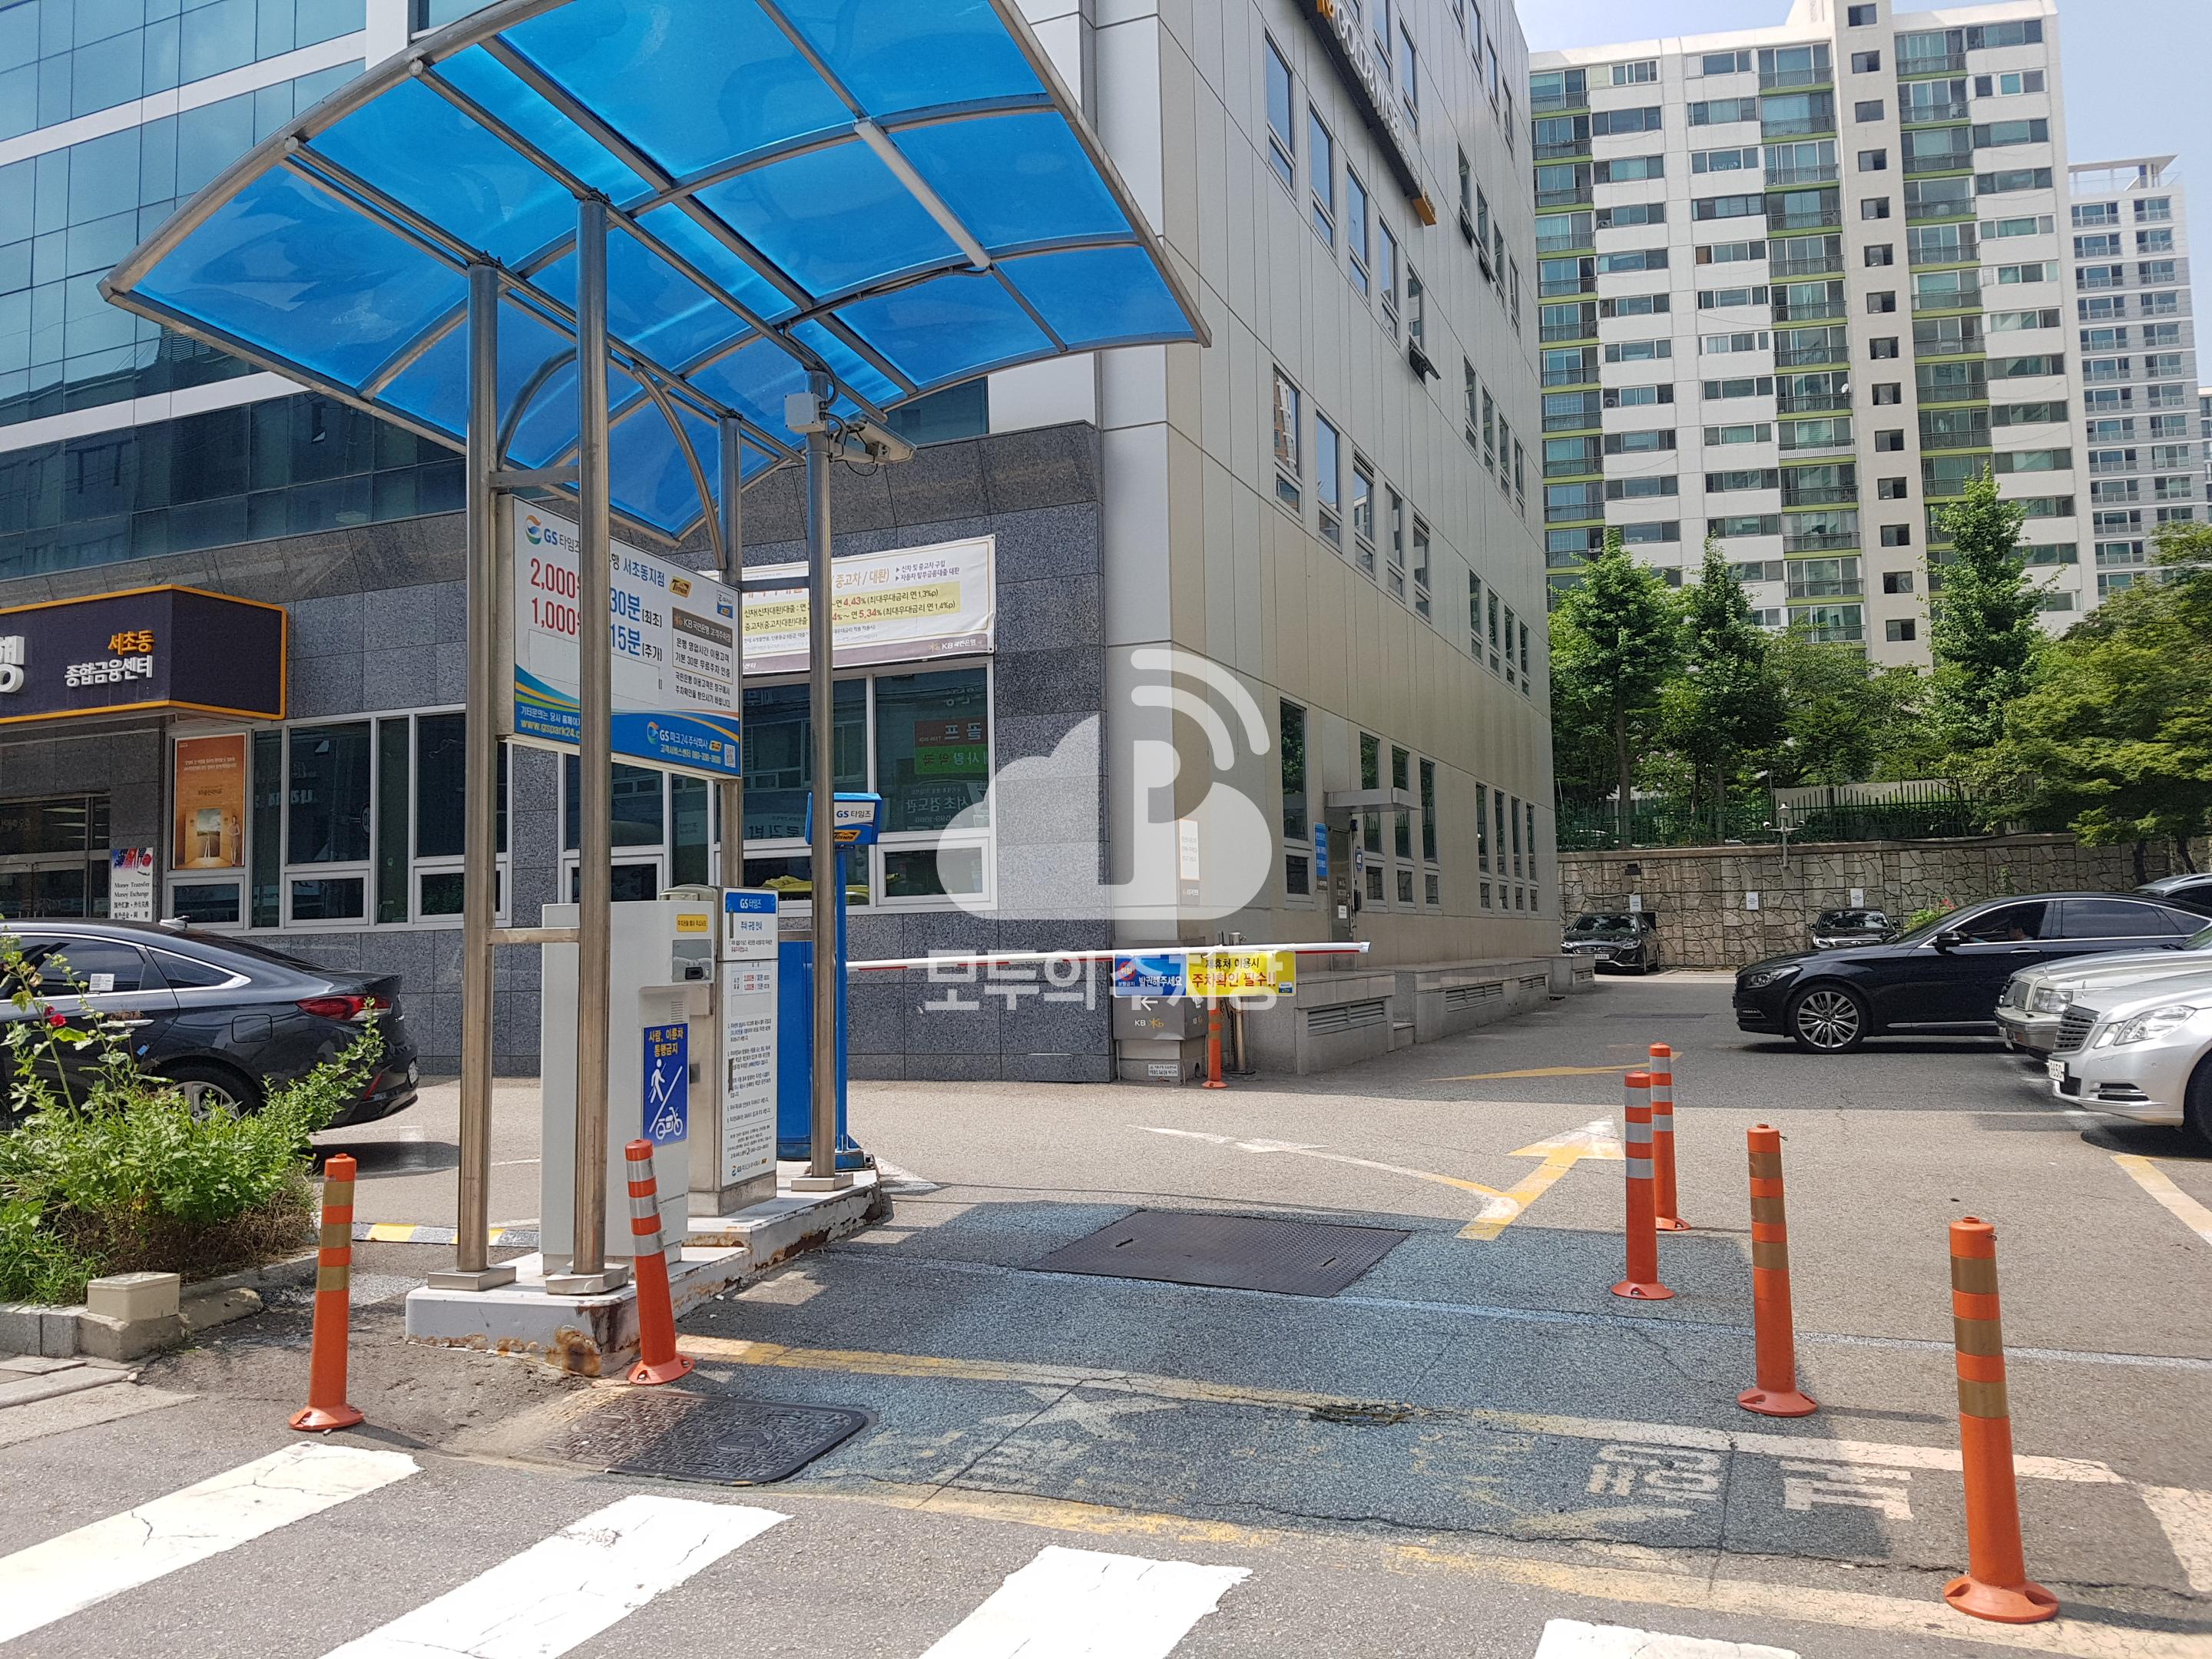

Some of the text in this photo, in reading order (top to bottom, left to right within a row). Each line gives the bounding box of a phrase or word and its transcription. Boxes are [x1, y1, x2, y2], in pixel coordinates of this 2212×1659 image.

[544, 528, 558, 546] GS
[530, 557, 581, 599] 2,000
[623, 557, 665, 588] 서초동지점
[835, 571, 861, 590] 중고차
[610, 587, 641, 623] 30분
[531, 596, 581, 636] 1,000
[108, 630, 154, 656] 서초동
[65, 655, 154, 687] 종합금융센터
[740, 898, 762, 909] GS 타임즈
[1206, 957, 1260, 969] 제휴처 이용시
[1138, 975, 1183, 988] 발권해주세요
[1191, 971, 1277, 988] 주차확인 필수!!
[649, 1030, 664, 1043] 사람,
